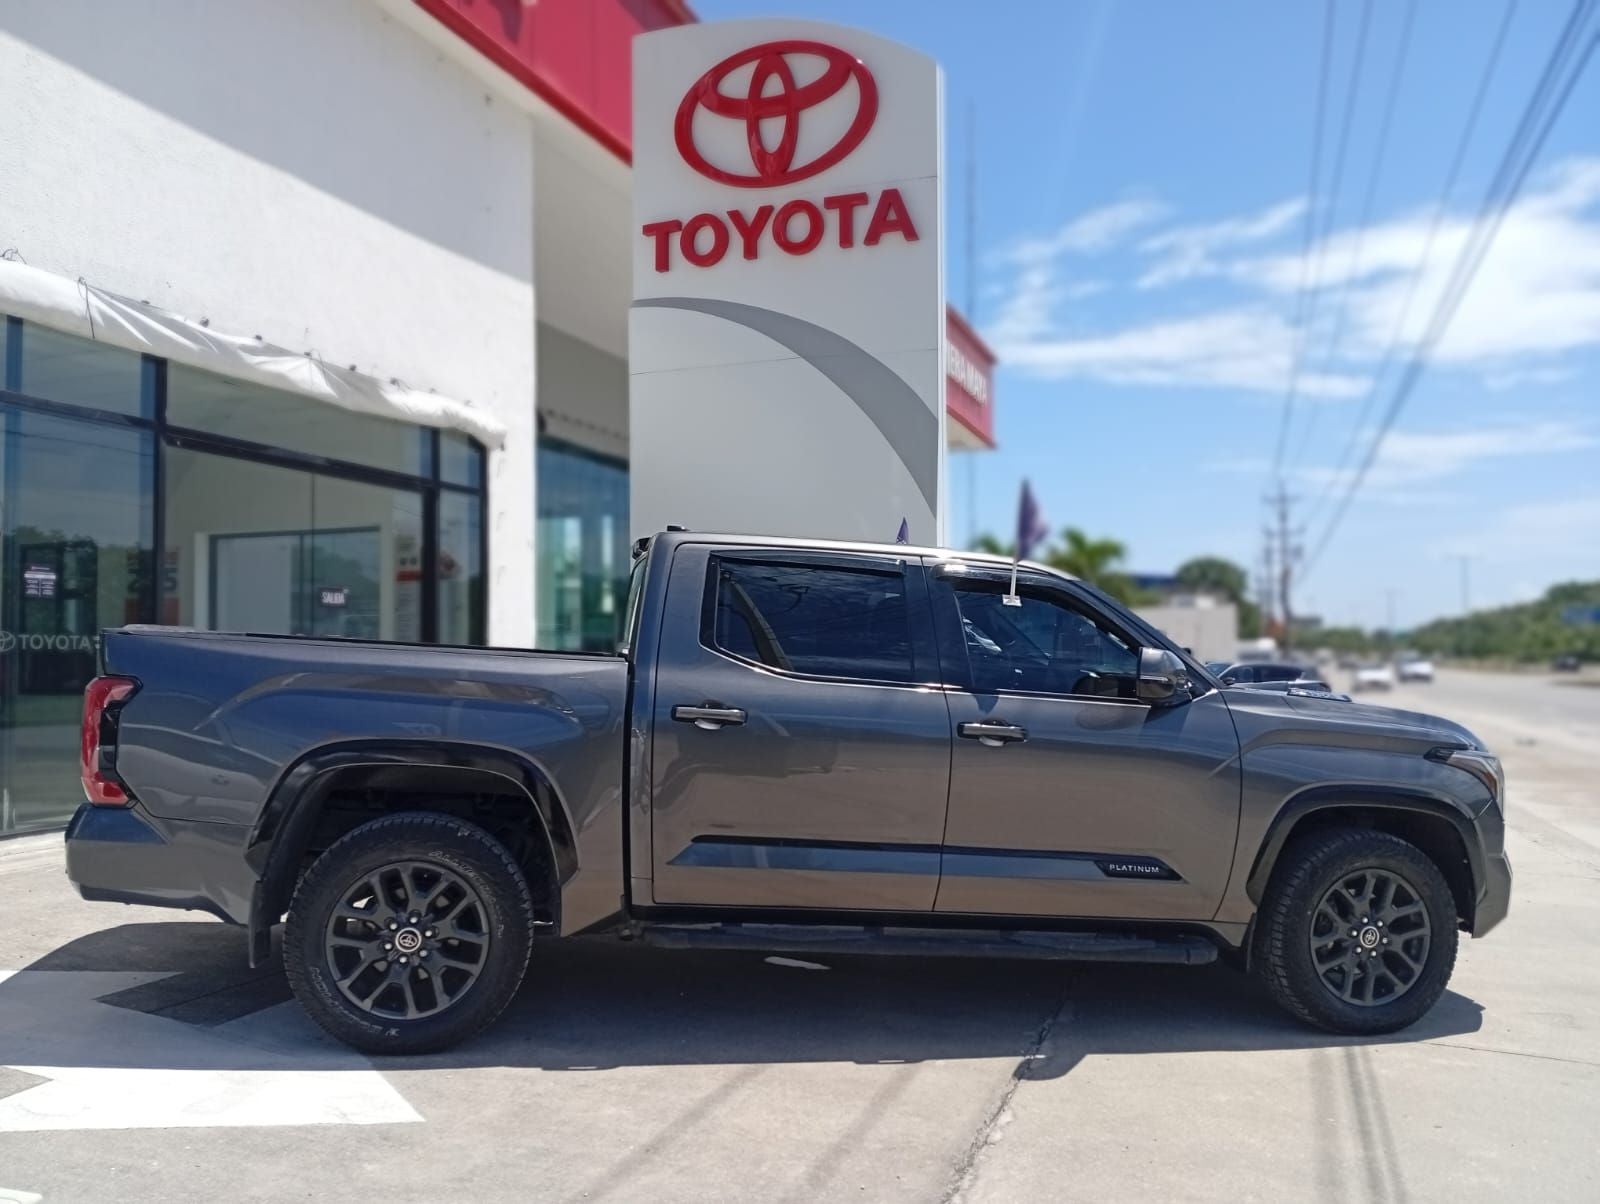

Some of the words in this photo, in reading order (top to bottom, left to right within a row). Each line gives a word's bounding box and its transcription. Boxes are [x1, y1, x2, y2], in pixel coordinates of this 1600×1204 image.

[642, 188, 919, 273] TOYOTA
[18, 634, 93, 650] TOYOTA
[1109, 863, 1160, 873] PLATINUM
